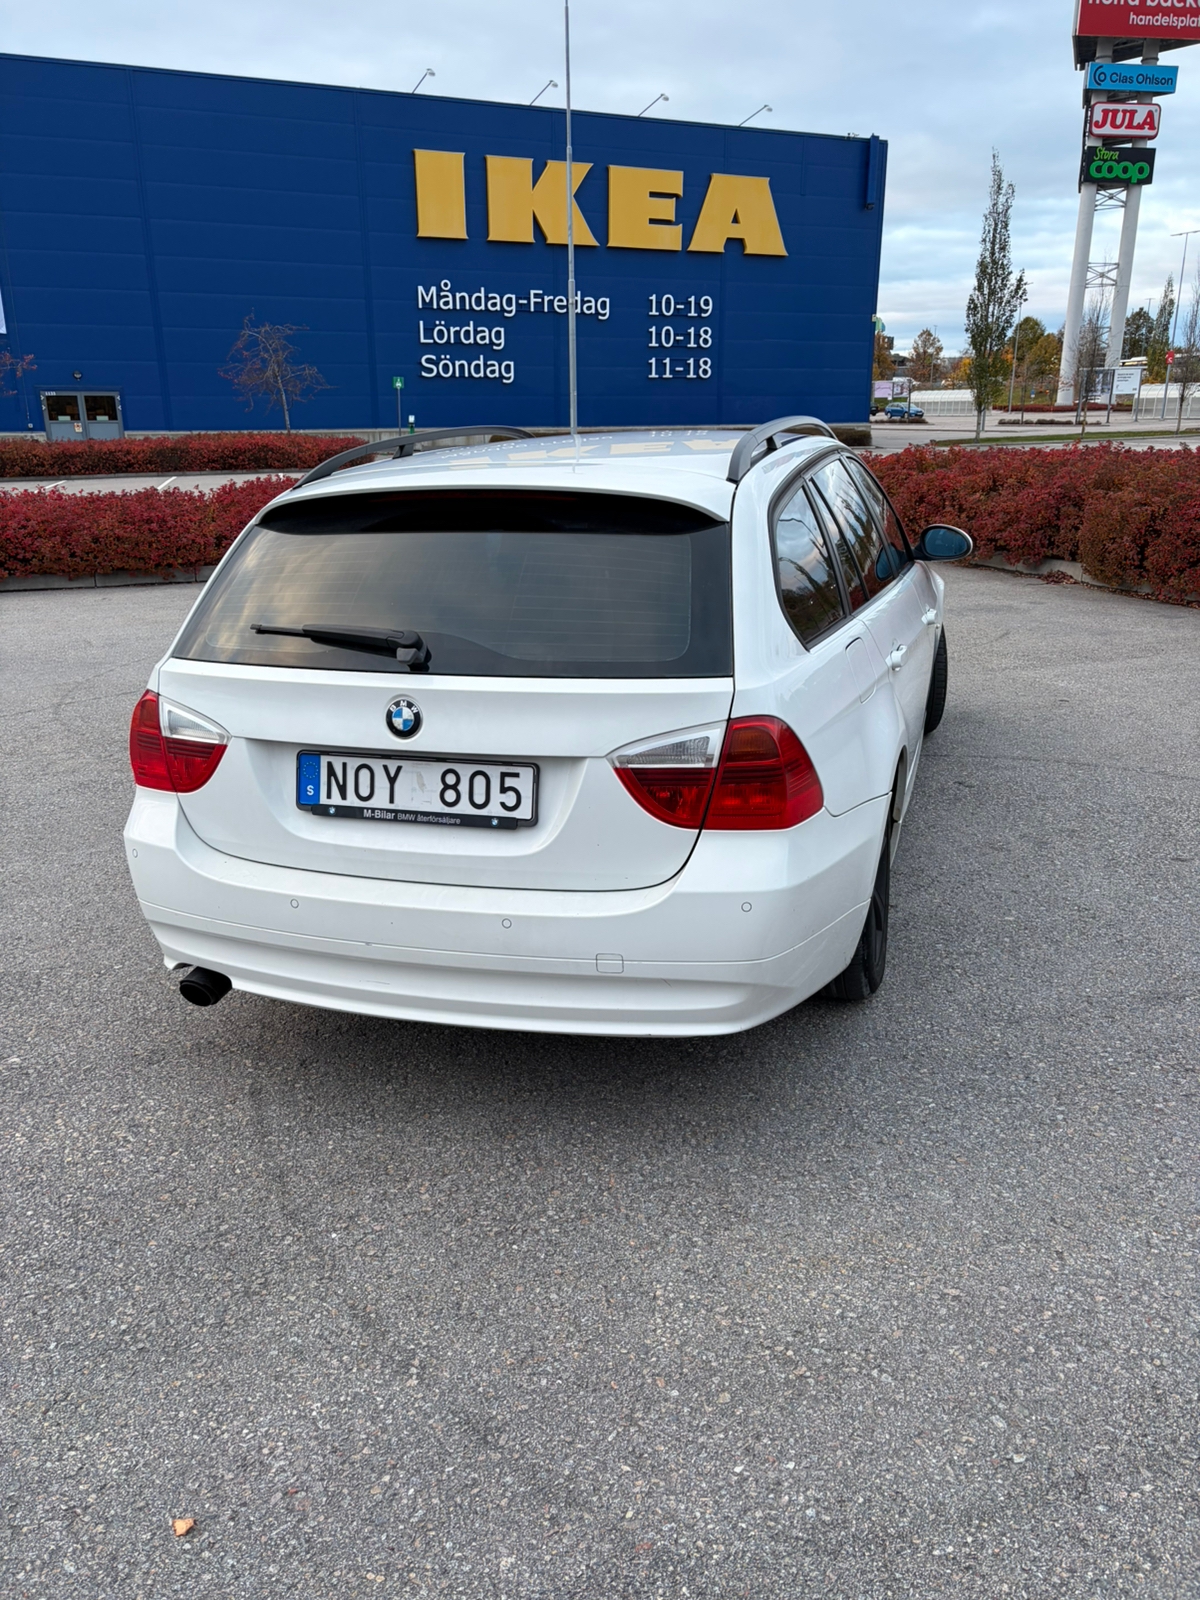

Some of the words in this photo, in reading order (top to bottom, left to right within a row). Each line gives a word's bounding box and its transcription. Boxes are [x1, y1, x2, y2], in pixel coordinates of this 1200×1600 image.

[1109, 72, 1134, 85] Clas
[1136, 73, 1173, 86] Ohlson
[1093, 108, 1156, 131] JULA
[1094, 147, 1119, 160] Stora
[1089, 161, 1150, 184] coop
[414, 148, 788, 257] IKEA
[648, 294, 713, 318] 10-19
[419, 320, 505, 350] Lördag
[648, 325, 712, 348] 10-18
[420, 354, 515, 384] Söndag
[648, 357, 712, 379] 11-18
[390, 700, 419, 714] BMW
[306, 785, 315, 796] S
[326, 760, 403, 805] NOY
[439, 768, 523, 812] 805
[363, 808, 395, 820] M-Bilar
[397, 812, 416, 821] BMW
